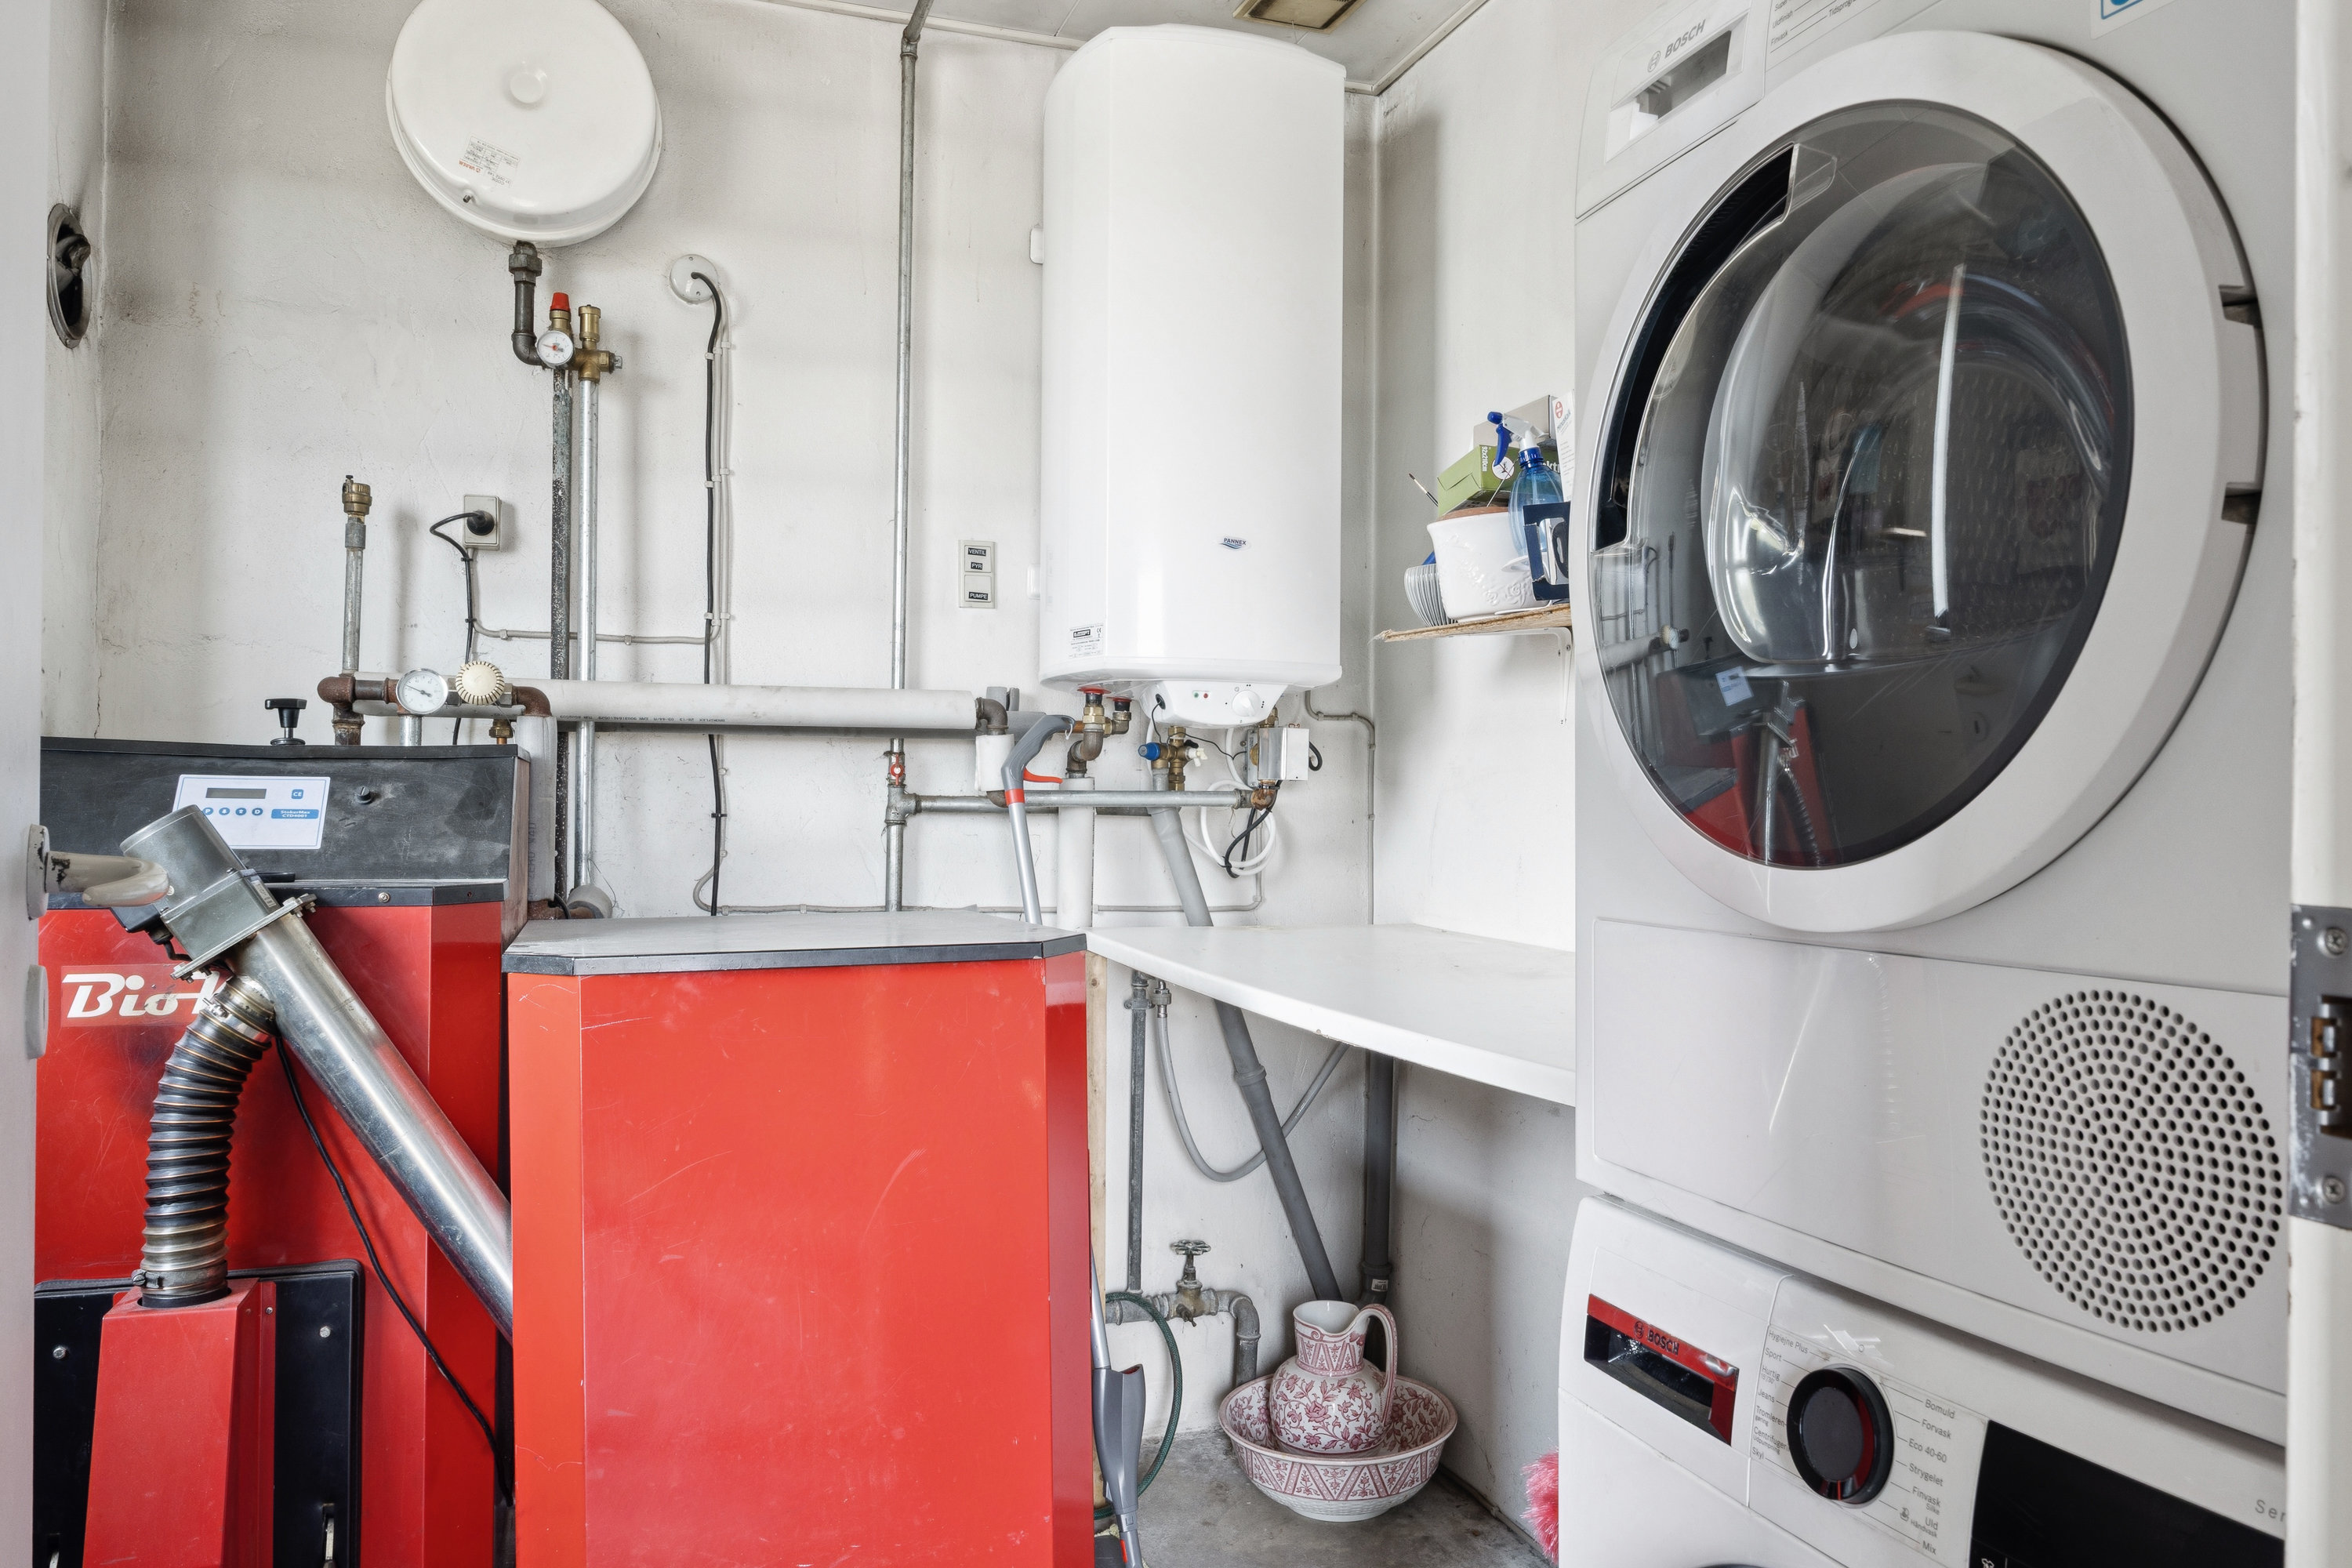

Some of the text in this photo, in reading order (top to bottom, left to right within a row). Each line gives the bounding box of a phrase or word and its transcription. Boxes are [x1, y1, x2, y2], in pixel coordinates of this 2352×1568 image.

[1664, 19, 1706, 59] BOSCH
[1223, 537, 1247, 546] PANNEX
[1647, 1328, 1679, 1356] BOSCH
[1769, 1330, 1809, 1354] Hygiejne Plus
[1764, 1347, 1783, 1362] Sport
[1762, 1365, 1780, 1381] Hurtig
[1758, 1388, 1775, 1403] Jeans
[1925, 1399, 1955, 1419] Bomuld
[1922, 1418, 1951, 1439] Forvask
[1751, 1446, 1764, 1460] Skyl
[1908, 1438, 1947, 1463] Eco 40-60
[1909, 1463, 1944, 1486] Strygelet
[1912, 1486, 1941, 1507] Finvask
[1926, 1503, 1940, 1515] Silke
[1910, 1519, 1938, 1537] Håndvask
[1925, 1516, 1939, 1530] Uld
[1922, 1540, 1936, 1555] Mix
